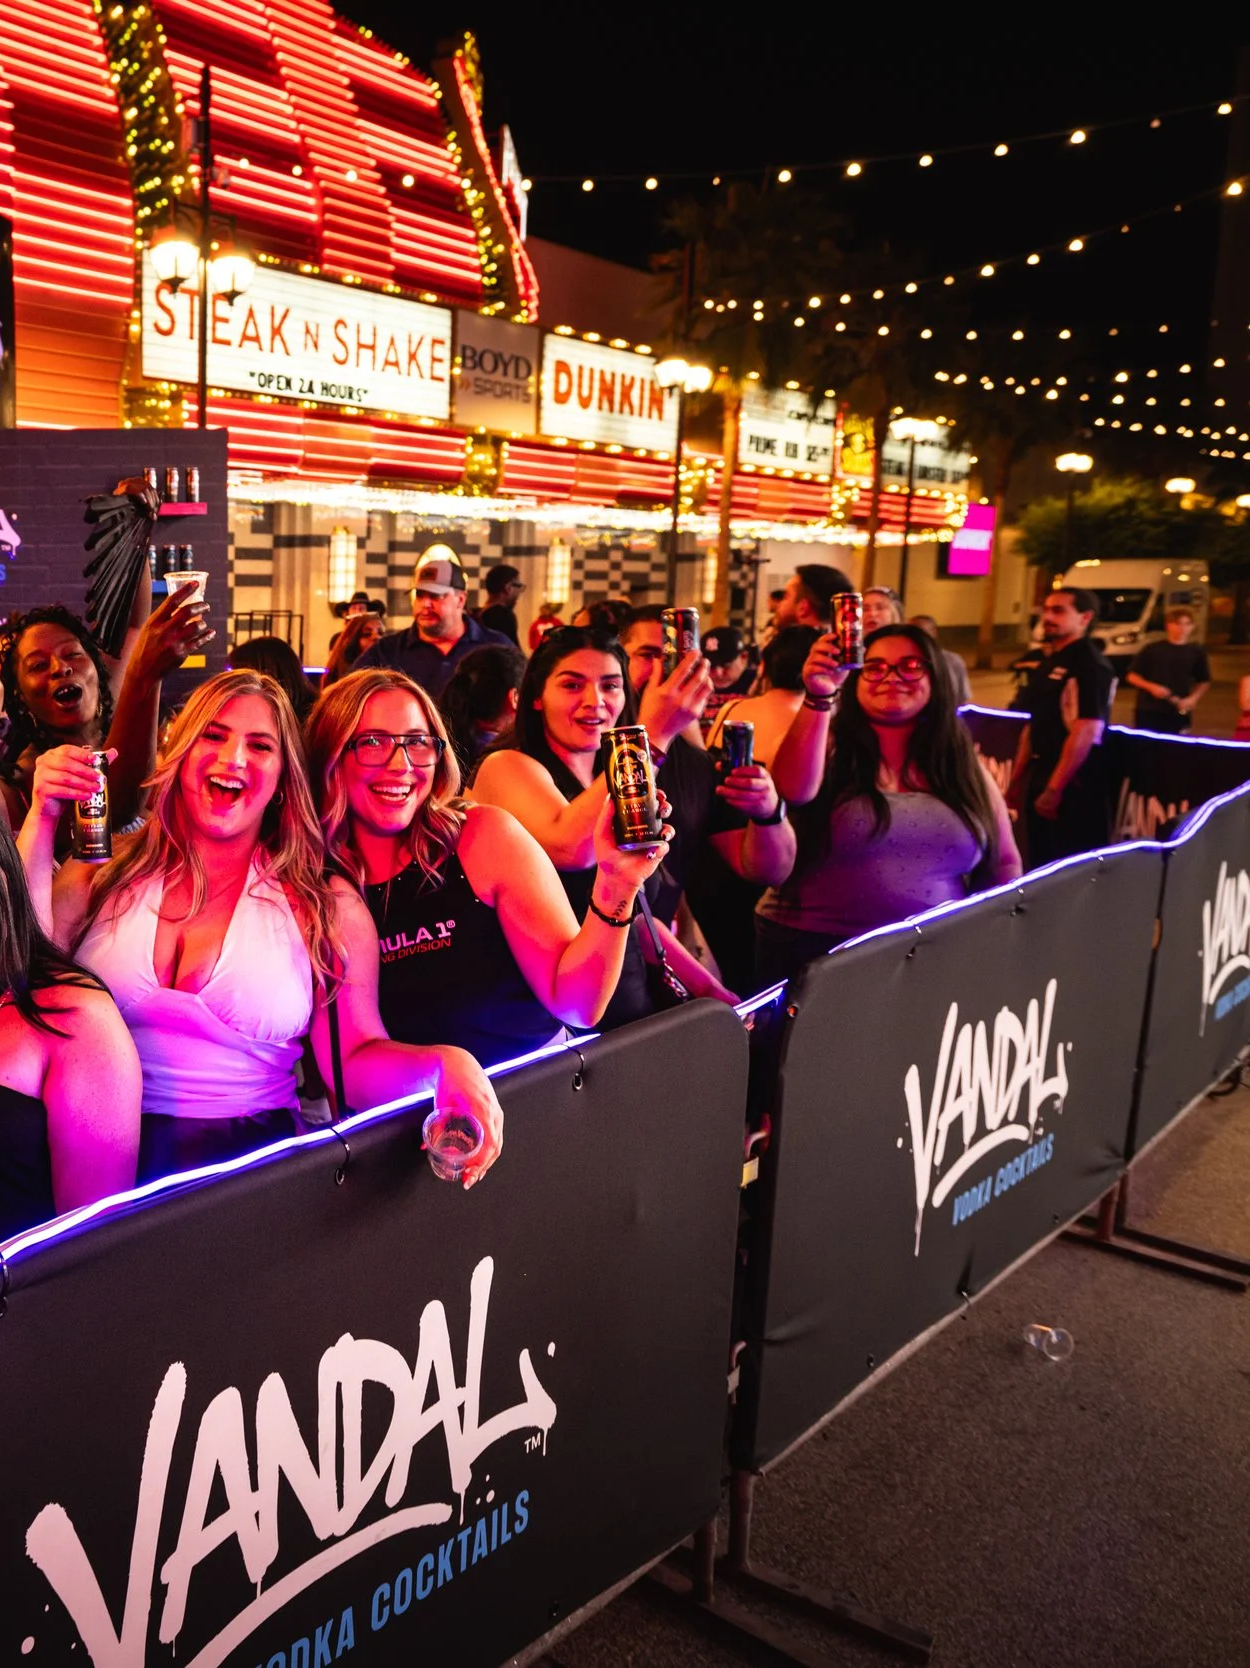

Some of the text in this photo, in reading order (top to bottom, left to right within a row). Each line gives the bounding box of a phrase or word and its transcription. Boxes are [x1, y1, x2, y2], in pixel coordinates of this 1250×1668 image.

[154, 282, 447, 383] STEAK N SHAKE
[460, 343, 533, 381] BOYD
[473, 377, 533, 404] SPORTS
[397, 938, 452, 960] DIVISION
[904, 978, 1070, 1225] VANDAL
[952, 1132, 1055, 1226] VODKA COCKTAILS
[25, 1255, 557, 1668] VANDAL
[370, 1489, 530, 1632] COCKTAILS
